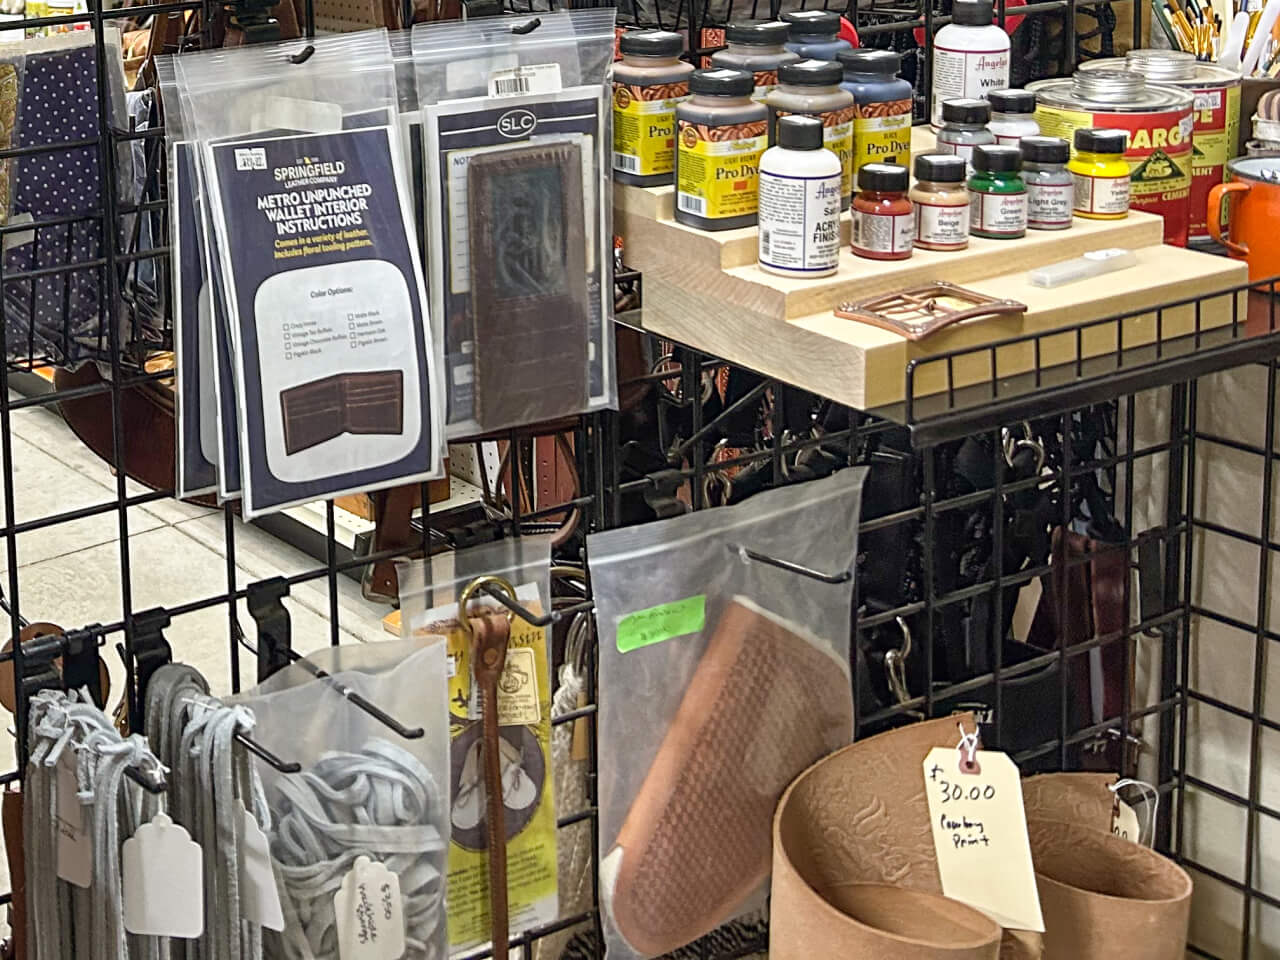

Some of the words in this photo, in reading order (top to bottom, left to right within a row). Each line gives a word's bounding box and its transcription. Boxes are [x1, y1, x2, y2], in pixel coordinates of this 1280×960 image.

[980, 78, 1005, 87] White
[501, 115, 533, 132] SLC
[649, 124, 671, 138] Pro
[867, 143, 889, 155] Pro
[890, 140, 910, 155] Dye
[274, 161, 345, 182] SPRINGFIELD
[715, 167, 739, 180] Pro
[284, 179, 309, 189] LEATHER
[310, 176, 338, 186] COMPANY
[257, 193, 301, 210] METRO
[301, 183, 372, 204] UNPUNCHED
[1051, 199, 1068, 207] Grey
[265, 205, 313, 223] WALLET
[314, 198, 369, 217] INTERIOR
[276, 212, 363, 235] INSTRUCTIONS
[938, 219, 960, 227] Beige
[274, 238, 298, 248] Comes
[312, 234, 335, 245] variety
[274, 248, 303, 259] Includes
[303, 244, 321, 257] floral
[321, 241, 346, 253] tooling
[310, 289, 326, 299] Color
[327, 287, 353, 296] Options:
[953, 834, 990, 848] Print
